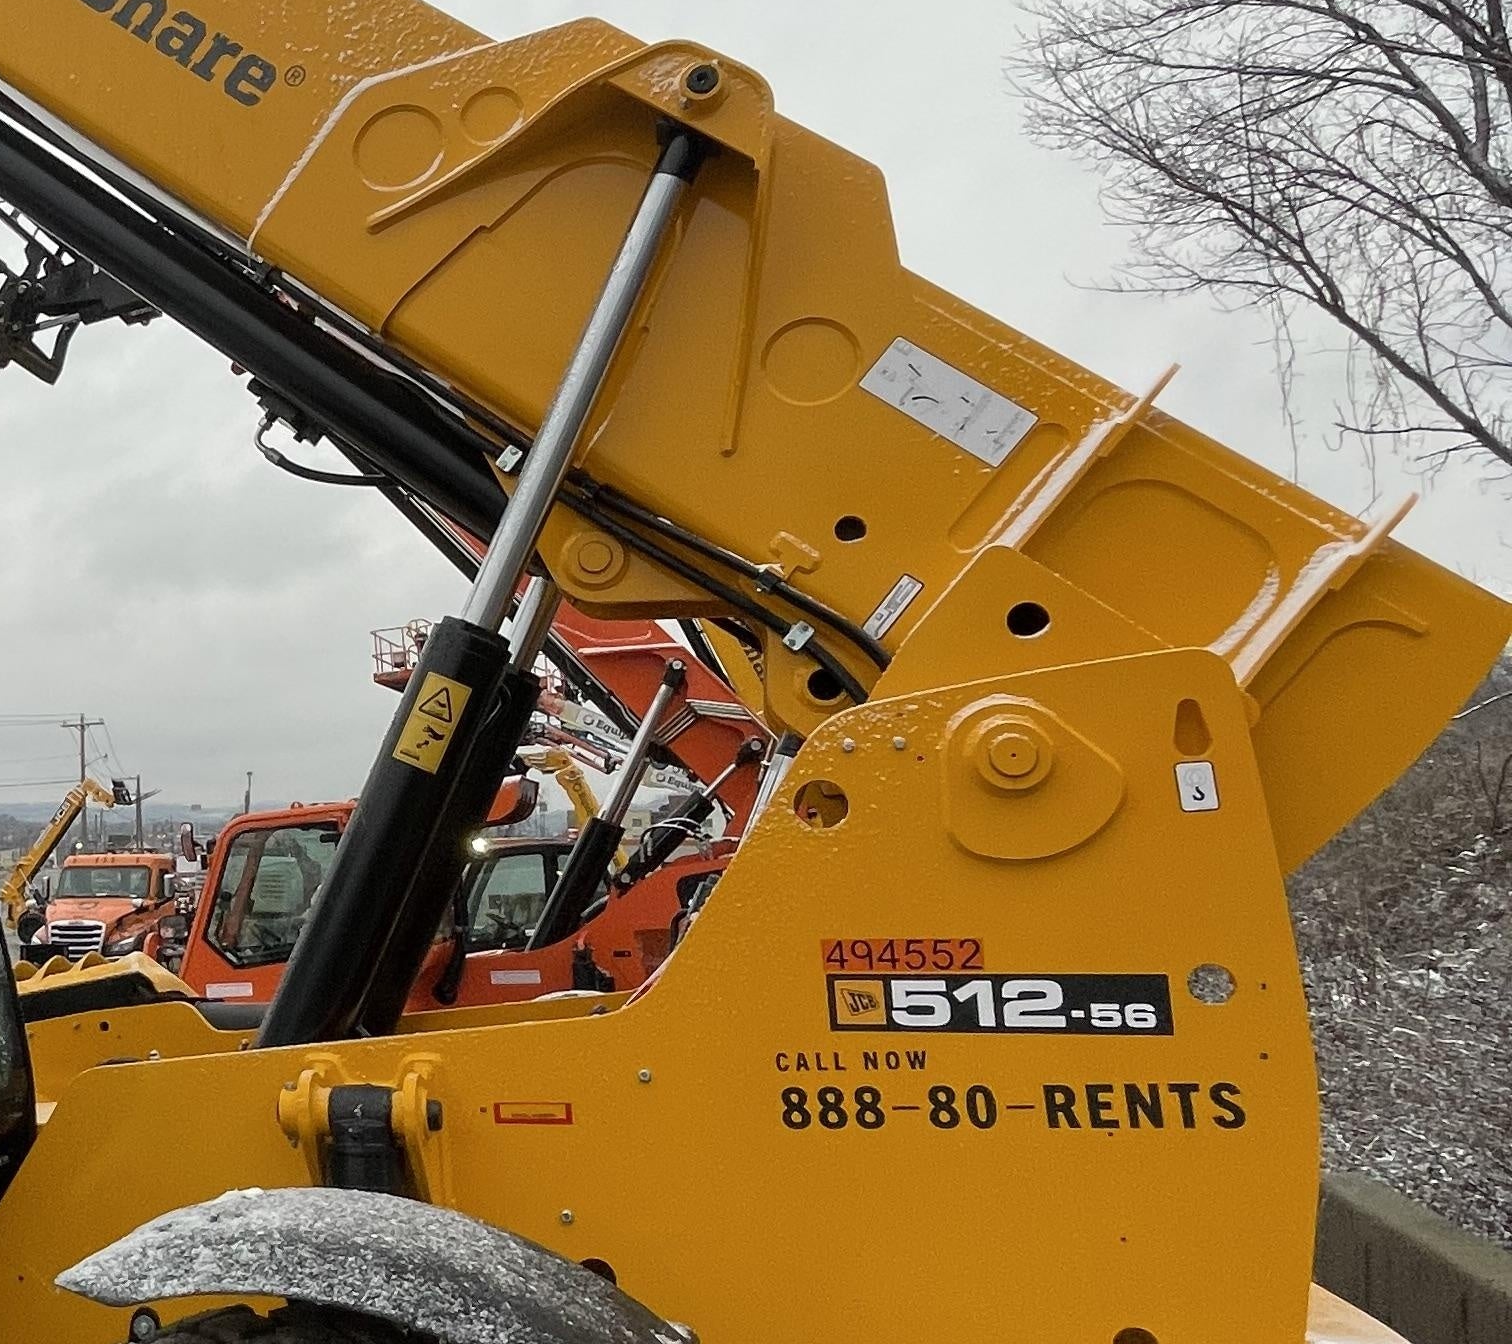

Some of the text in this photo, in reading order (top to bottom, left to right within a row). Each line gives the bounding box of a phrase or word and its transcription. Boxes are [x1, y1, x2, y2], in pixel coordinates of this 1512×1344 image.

[826, 939, 983, 970] 494552
[848, 991, 878, 1013] JCB
[775, 1051, 927, 1072] CALL NOW
